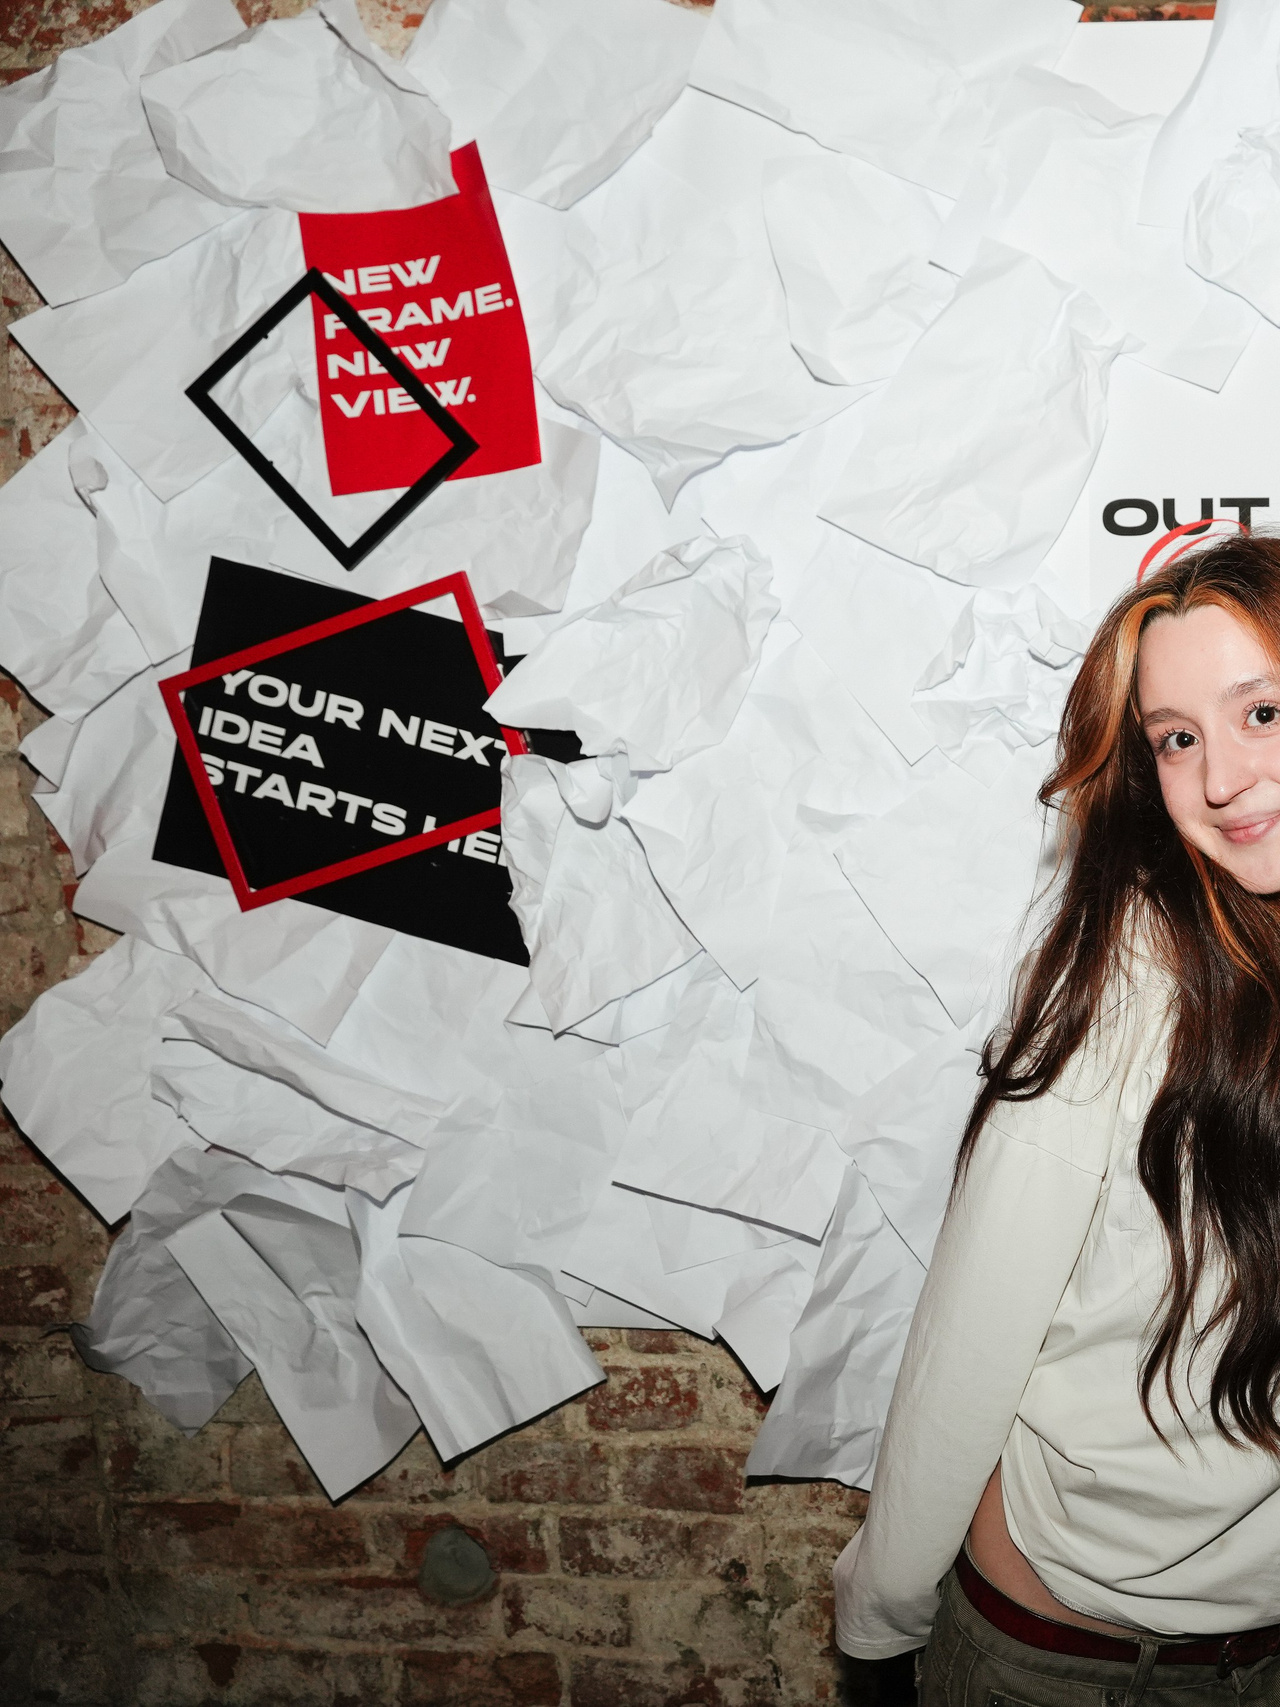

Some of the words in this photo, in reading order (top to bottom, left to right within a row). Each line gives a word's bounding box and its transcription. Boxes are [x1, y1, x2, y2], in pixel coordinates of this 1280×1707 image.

[322, 254, 442, 296] NEW
[323, 282, 515, 341] FRAME.
[330, 376, 477, 419] VIEW.
[1102, 497, 1270, 536] OUT
[221, 669, 365, 731] YOUR
[198, 706, 326, 770] IDEA
[200, 752, 408, 836] STARTS
